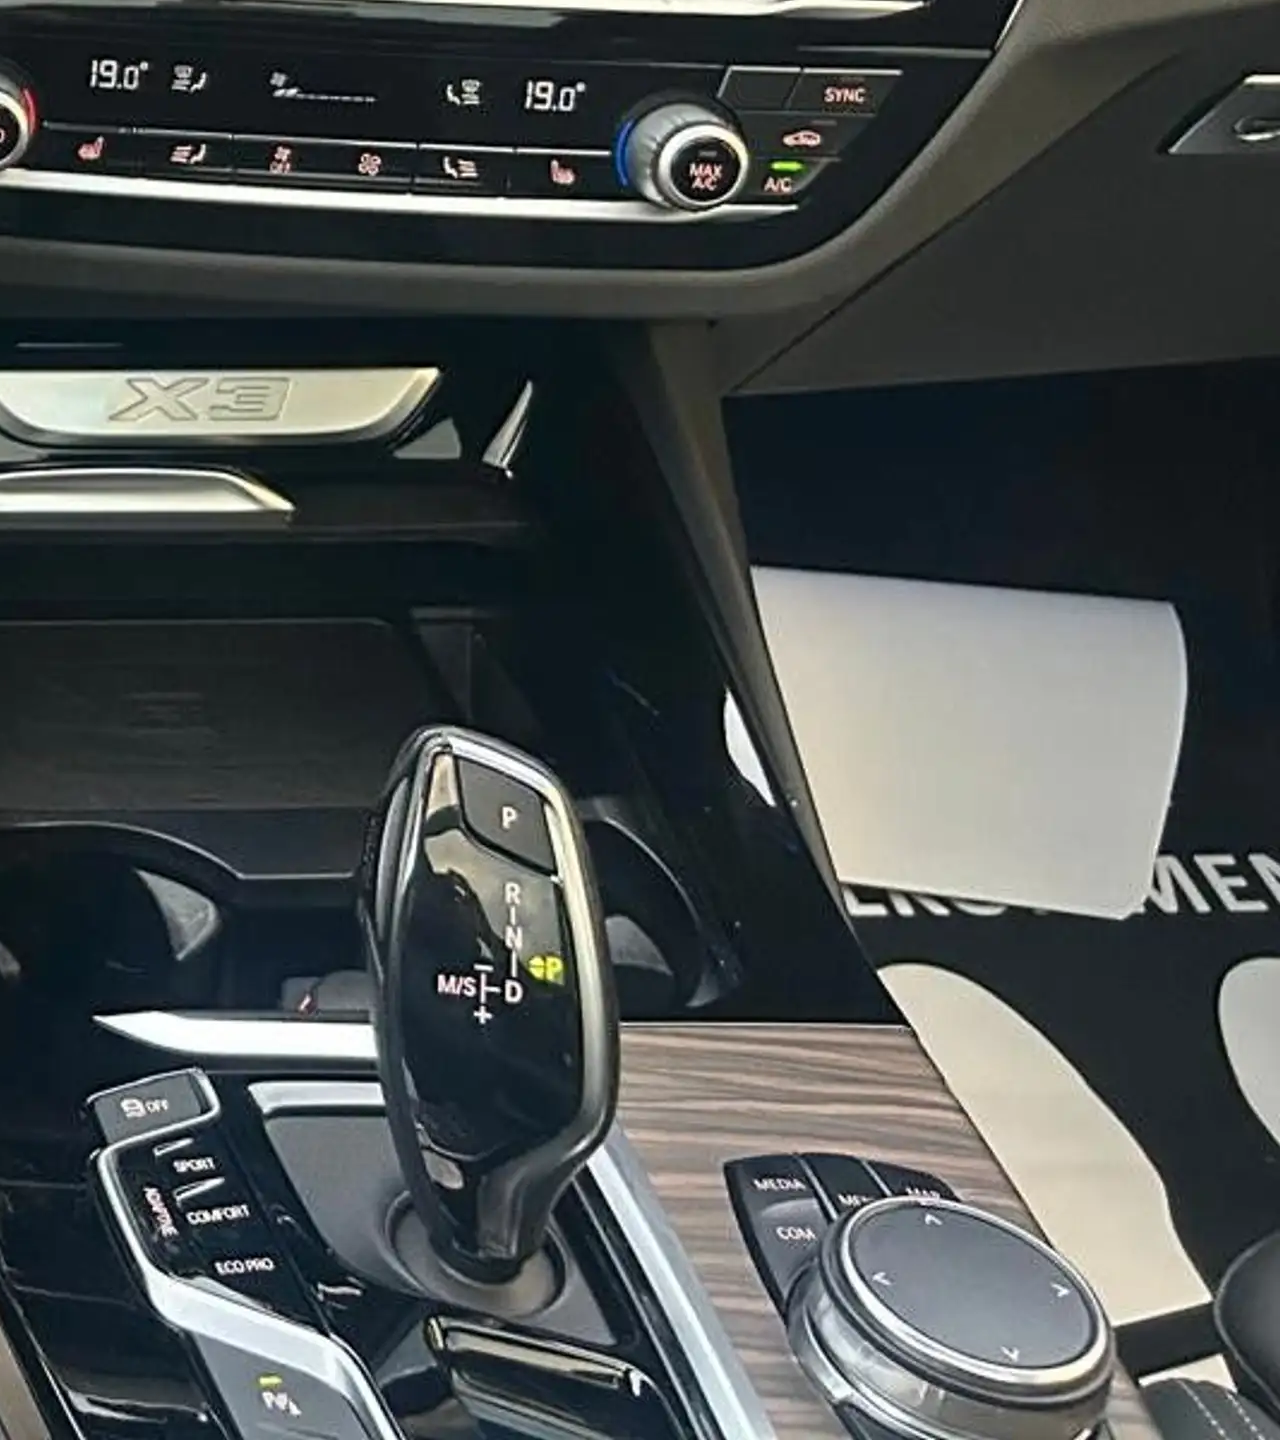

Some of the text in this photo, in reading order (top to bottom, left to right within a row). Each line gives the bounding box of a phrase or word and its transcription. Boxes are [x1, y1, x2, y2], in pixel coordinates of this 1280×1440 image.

[822, 86, 867, 104] SYNC
[689, 163, 723, 179] MAX
[763, 177, 792, 194] A/C
[108, 376, 292, 423] X3
[501, 805, 519, 830] P
[504, 881, 521, 905] R
[505, 926, 523, 950] N
[436, 973, 524, 1004] M/S D
[144, 1098, 169, 1114] OFF
[172, 1156, 216, 1173] SPORT
[752, 1176, 808, 1192] MEDIA
[185, 1204, 251, 1225] COMFORT
[775, 1225, 817, 1242] COM
[214, 1257, 275, 1276] ECO PRO
